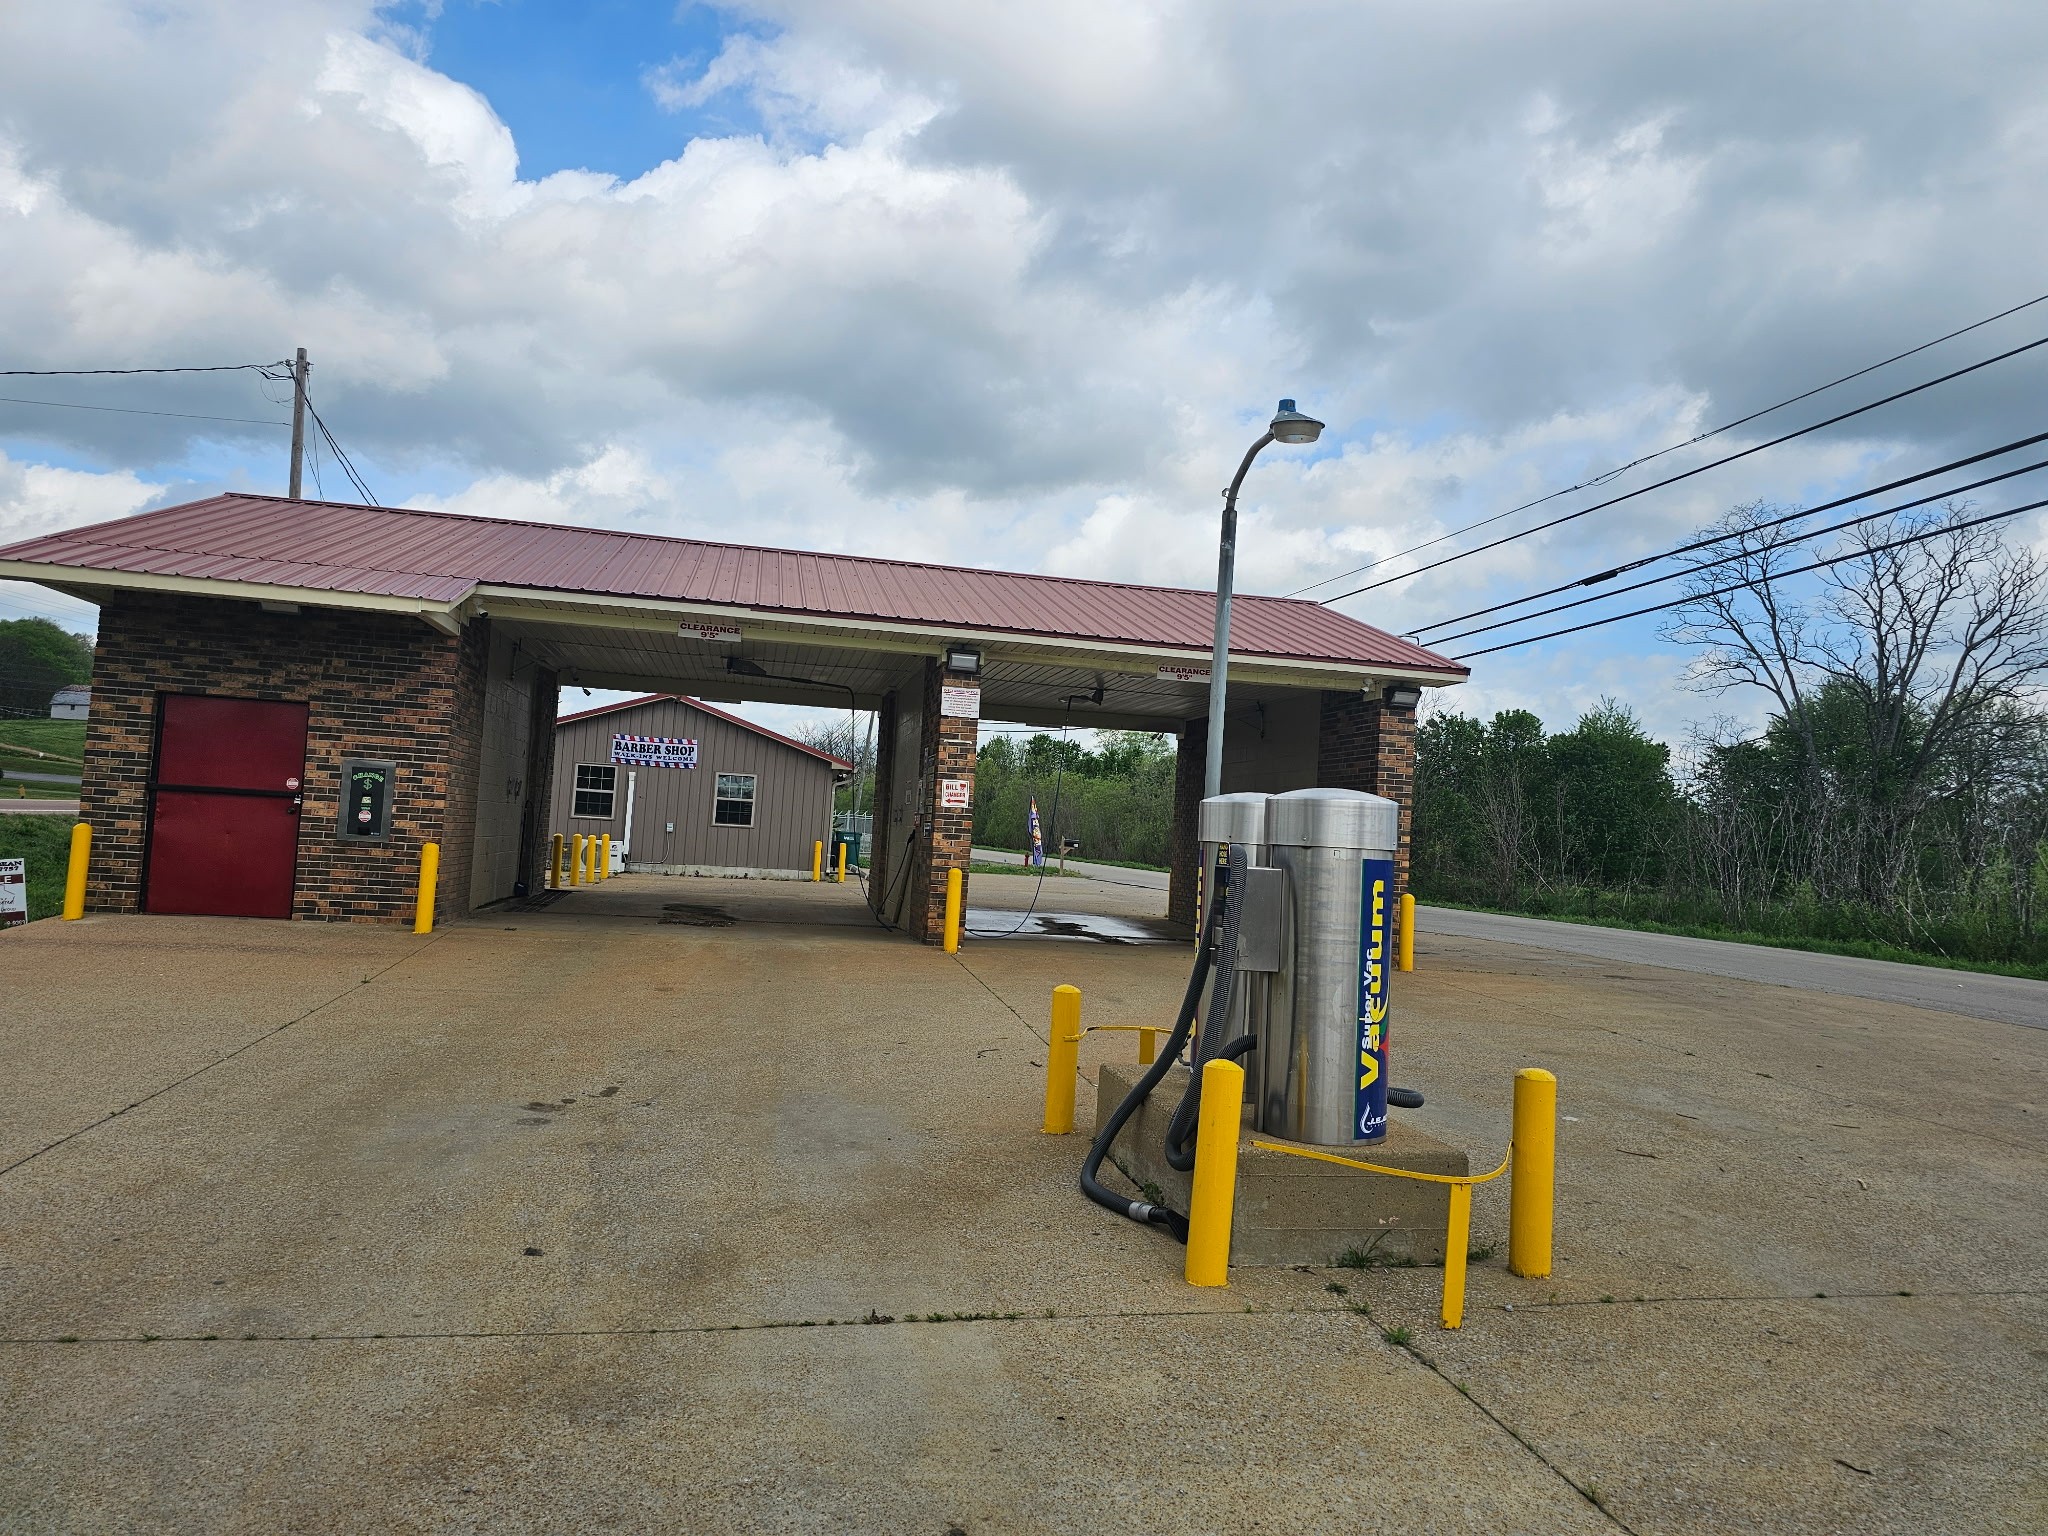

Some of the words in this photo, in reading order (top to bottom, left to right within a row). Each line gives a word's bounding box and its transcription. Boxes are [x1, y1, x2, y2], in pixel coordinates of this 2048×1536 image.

[680, 622, 741, 634] CLEARANCE
[1159, 666, 1211, 676] CLEARANCE
[614, 740, 662, 755] BARBER
[664, 745, 695, 757] SHOP
[614, 752, 653, 760] WALK-INS
[1363, 948, 1374, 987] Vac
[1360, 879, 1386, 1090] Vacuum
[1359, 992, 1375, 1050] Super
